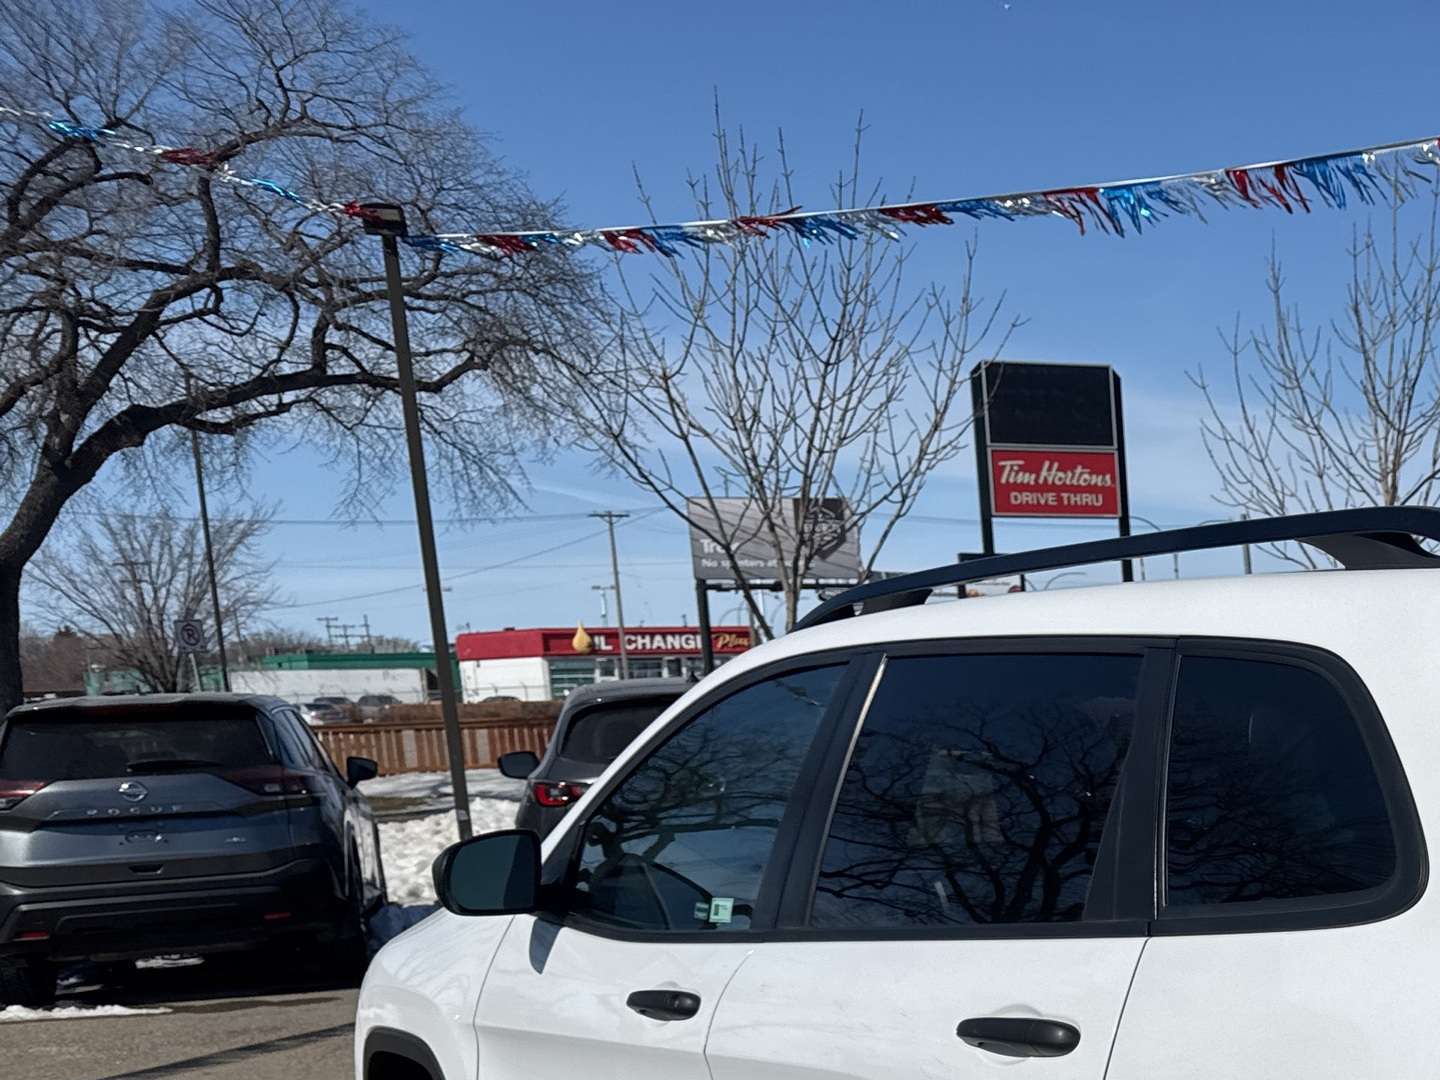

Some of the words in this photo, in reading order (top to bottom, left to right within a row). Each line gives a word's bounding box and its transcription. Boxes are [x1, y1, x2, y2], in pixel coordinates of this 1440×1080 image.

[998, 459, 1035, 485] Tim
[1040, 460, 1113, 487] Hortons
[1010, 491, 1057, 505] DRIVE
[1061, 492, 1103, 507] THRU
